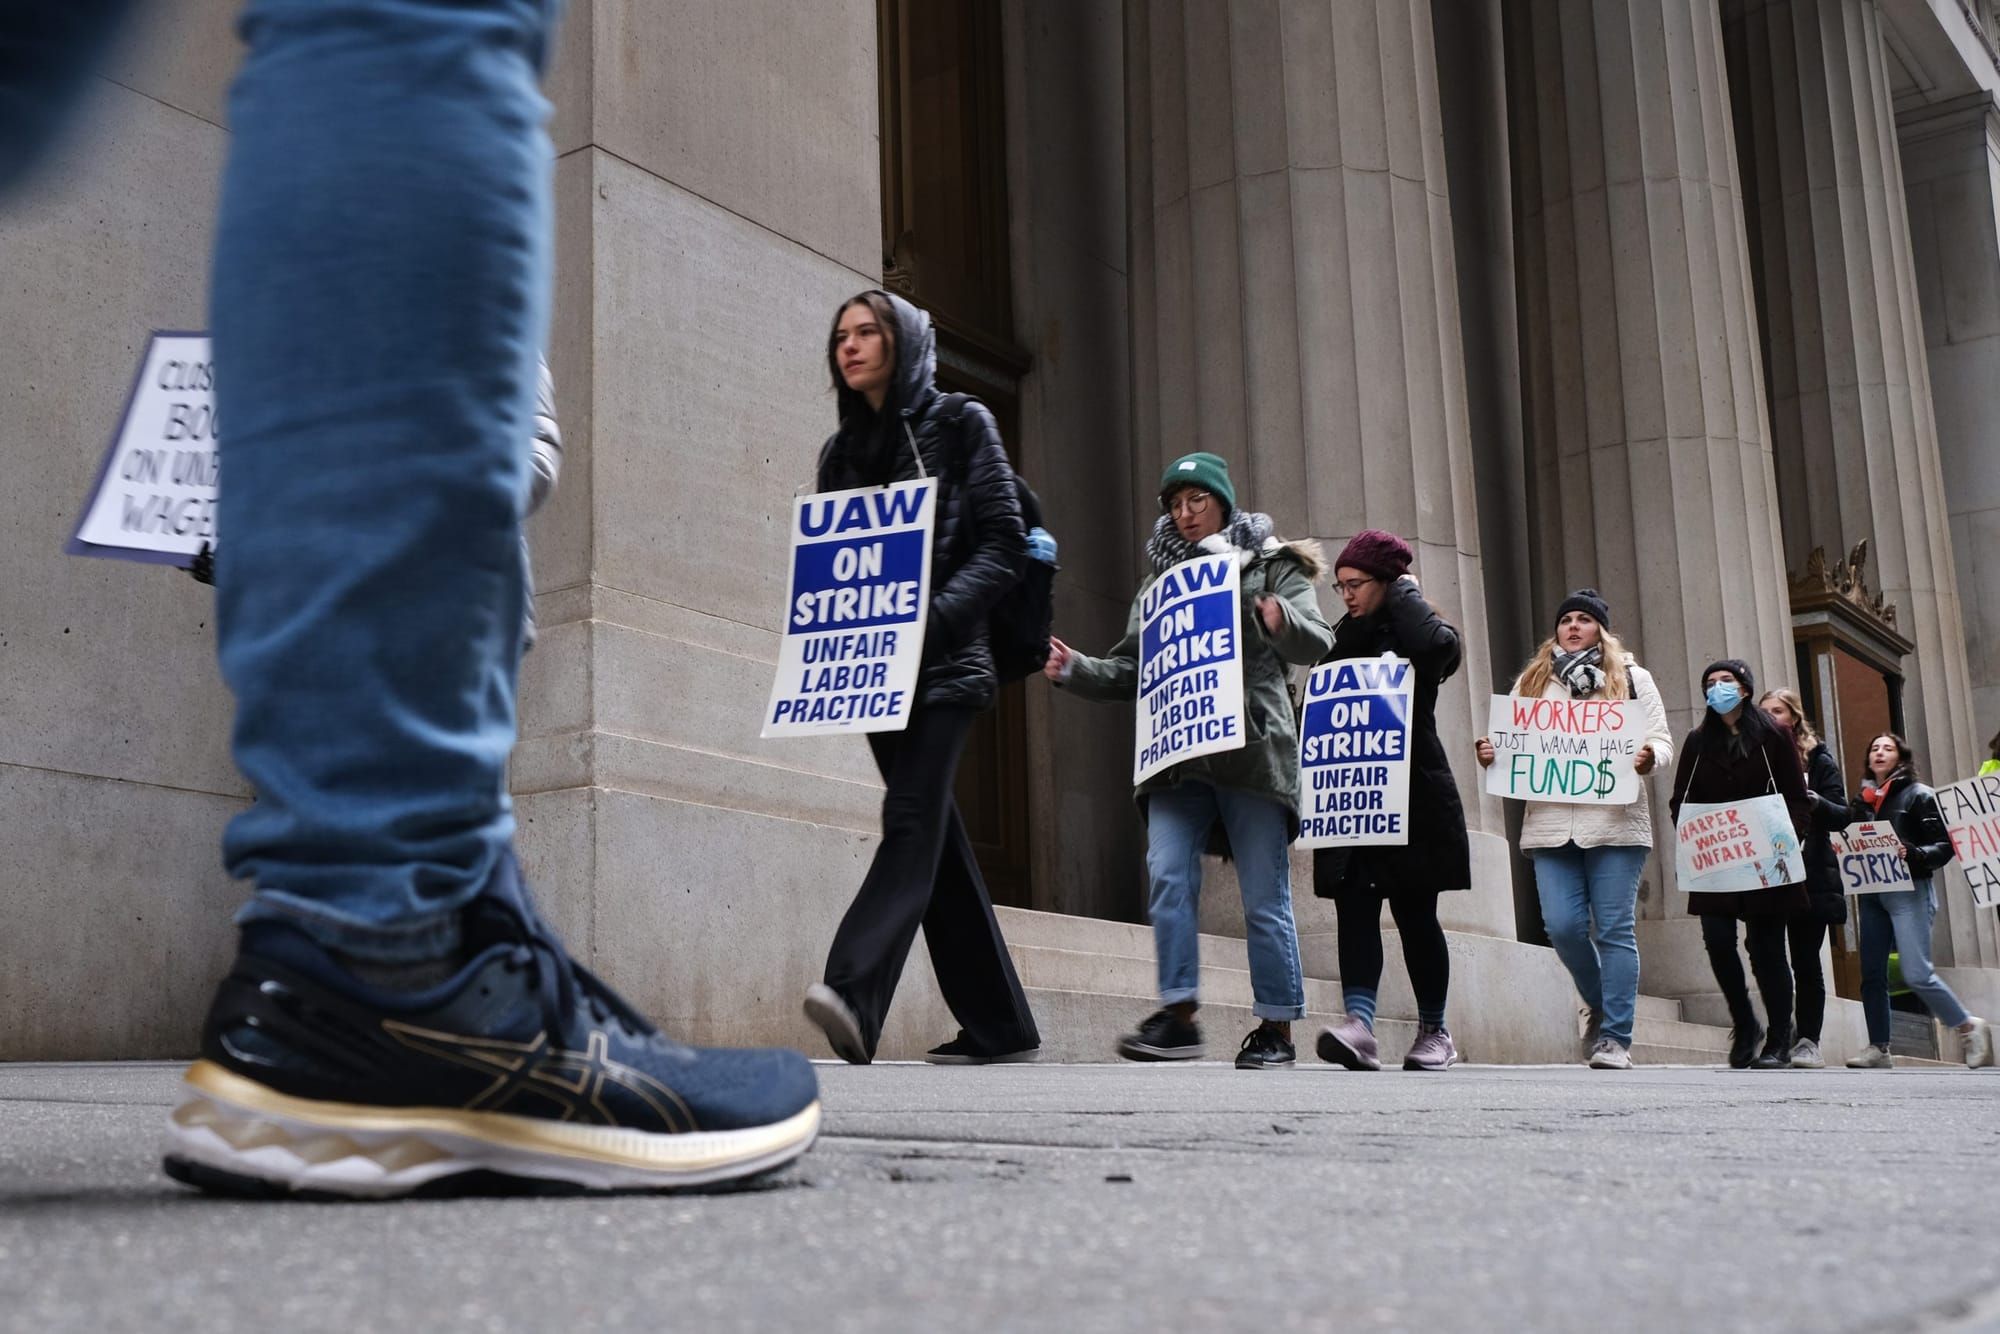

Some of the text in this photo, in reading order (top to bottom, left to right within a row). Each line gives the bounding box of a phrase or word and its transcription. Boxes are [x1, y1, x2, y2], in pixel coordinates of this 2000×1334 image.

[121, 449, 221, 487] ON UNF
[120, 494, 220, 537] WAGE
[799, 486, 930, 538] UAW
[832, 542, 884, 582] ON
[792, 580, 919, 627] STRIKE
[1142, 559, 1233, 622] UAW
[1159, 603, 1196, 644] ON
[802, 630, 898, 665] UNFAIR
[1141, 627, 1232, 690] STRIKE
[800, 662, 888, 694] LABOR
[1149, 668, 1219, 716] UNFAIR
[1309, 663, 1410, 697] UAW
[772, 690, 905, 725] PRACTICE
[1151, 695, 1215, 739] LABOR
[1330, 699, 1371, 729] ON
[1512, 699, 1625, 735] WORKERS
[1140, 715, 1237, 771] PRACTICE
[1303, 729, 1402, 762] STRIKE
[1493, 731, 1635, 756] JUST WANNA HAVE
[1312, 766, 1389, 791] UNFAIR
[1510, 754, 1616, 800] FUND$
[1314, 790, 1384, 814] LABOR
[1936, 776, 2000, 825] FAIR
[1299, 813, 1401, 839] PRACTICE
[1679, 809, 1741, 843] HARPER
[1695, 823, 1750, 851] WAGES
[1691, 840, 1757, 871] UNFAIR
[1843, 853, 1910, 887] STRIKE
[1963, 857, 2000, 904] FA
